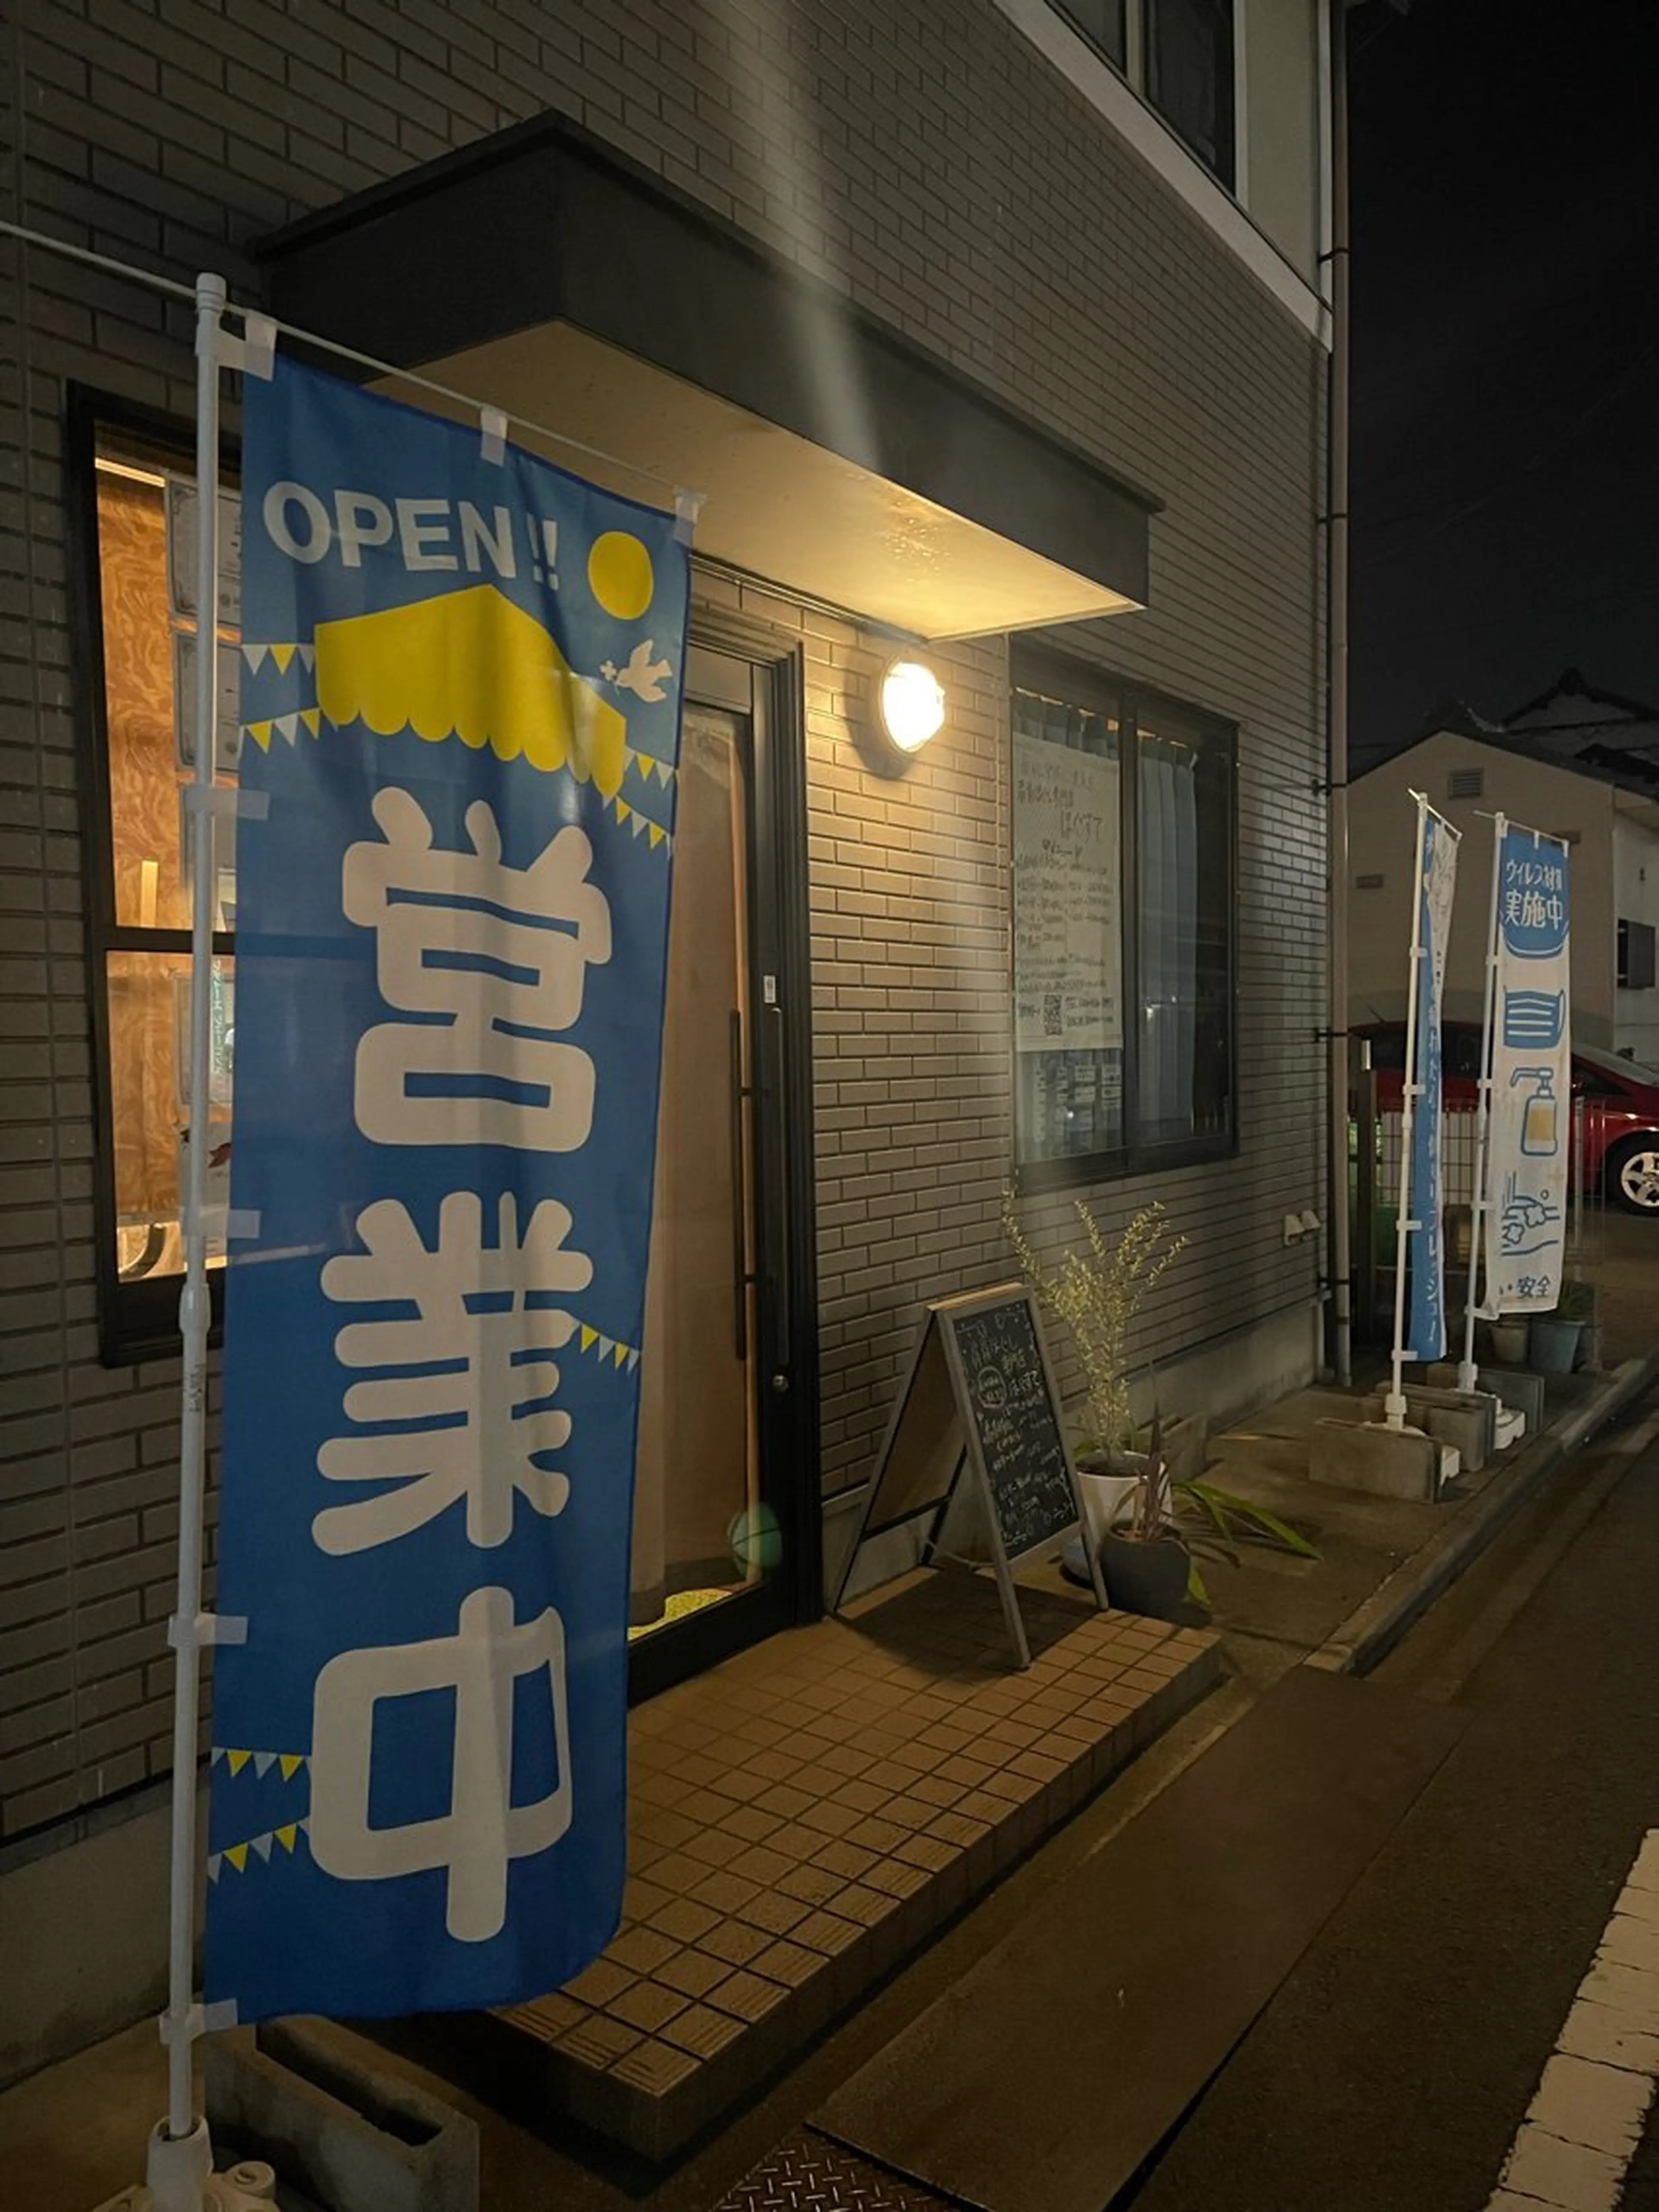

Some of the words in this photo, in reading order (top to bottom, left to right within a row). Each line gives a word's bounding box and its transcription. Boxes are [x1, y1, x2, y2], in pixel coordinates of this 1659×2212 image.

[1504, 888, 1563, 930] 実施中
[308, 785, 613, 1943] 営業中
